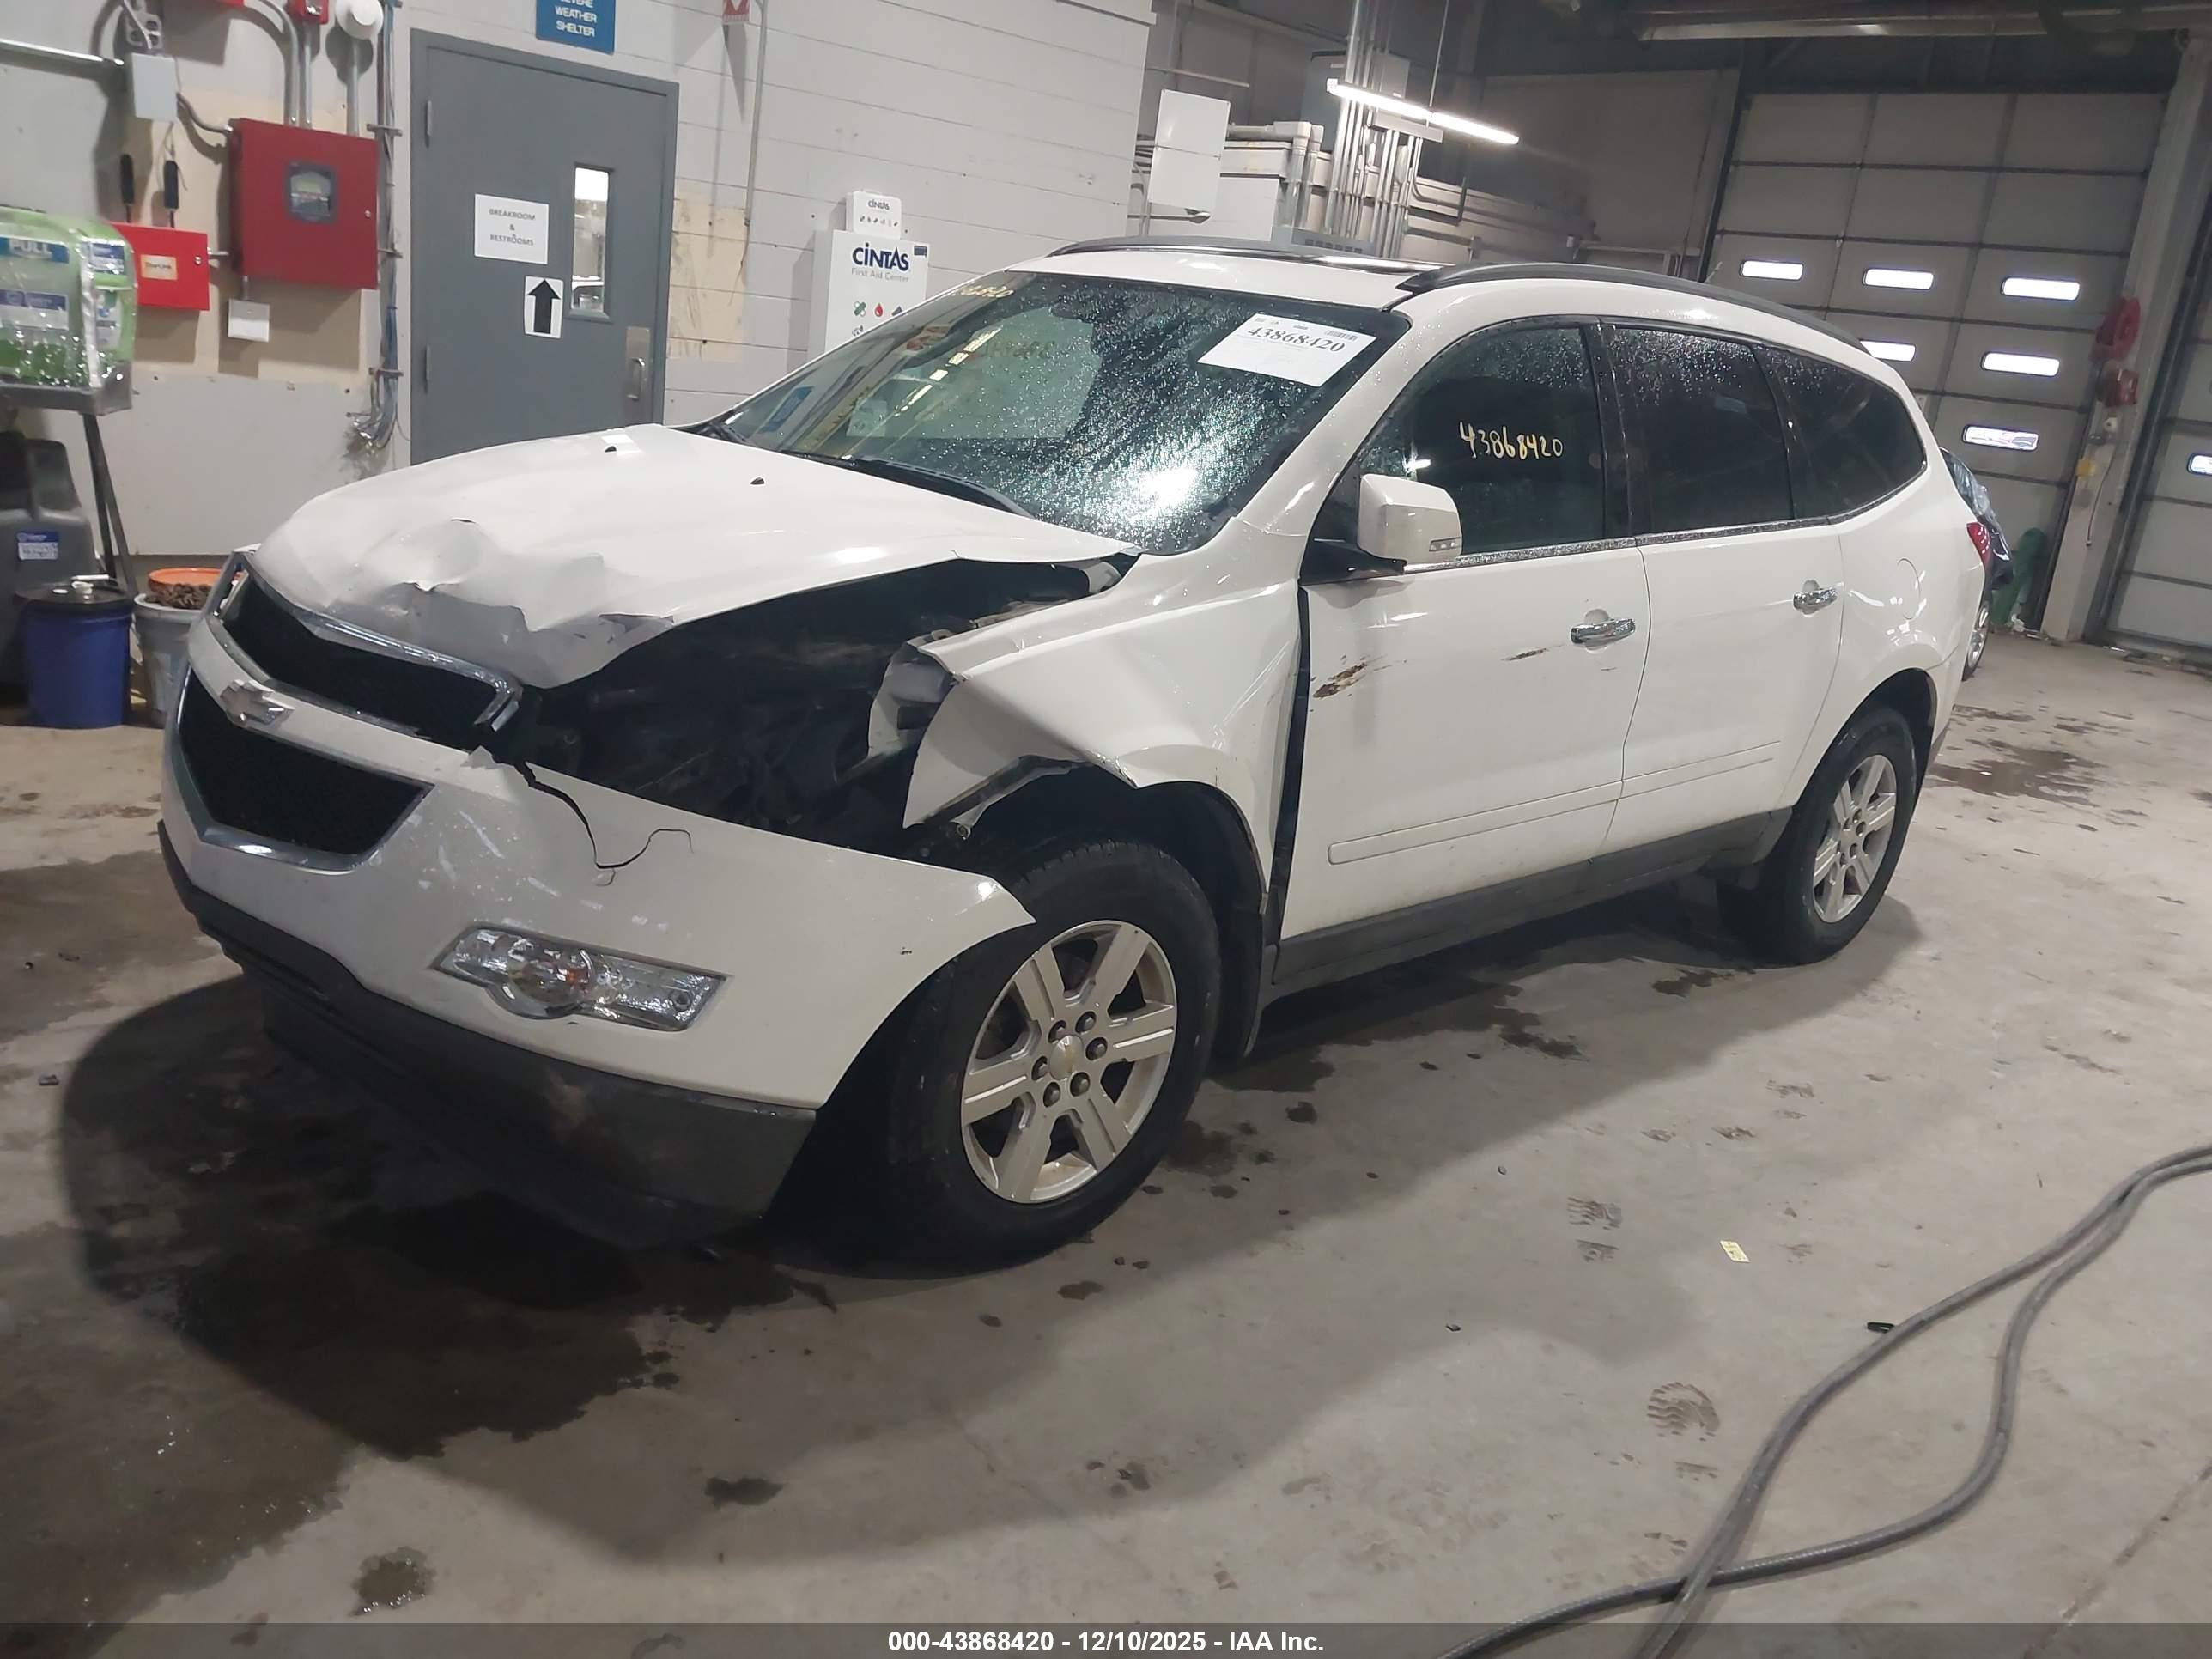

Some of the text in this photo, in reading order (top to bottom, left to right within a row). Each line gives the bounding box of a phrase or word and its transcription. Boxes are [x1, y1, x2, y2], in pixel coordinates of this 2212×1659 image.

[555, 5, 598, 24] WEATHER
[556, 20, 595, 37] SHELTER
[489, 209, 536, 221] BREAKROOM
[489, 234, 534, 246] RESTROOMS
[852, 242, 909, 271] CINTAS
[1248, 326, 1346, 352] 43868420
[1460, 421, 1564, 460] 43868420
